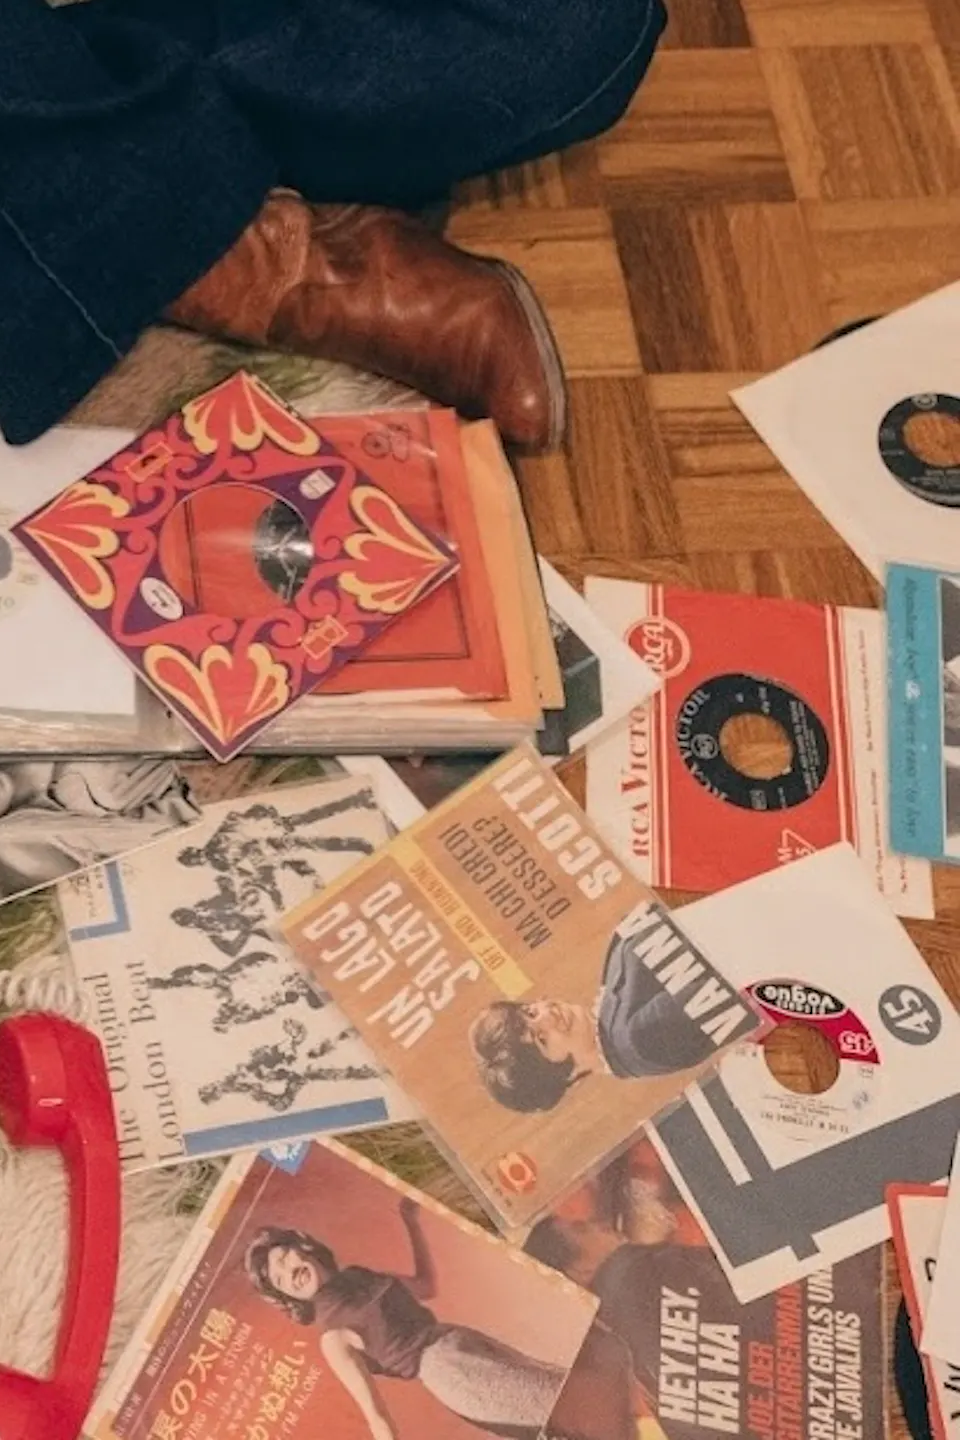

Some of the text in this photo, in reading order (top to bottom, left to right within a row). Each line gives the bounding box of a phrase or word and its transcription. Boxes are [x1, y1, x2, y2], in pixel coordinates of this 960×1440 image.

[621, 705, 649, 857] RCA VICTO
[676, 688, 711, 761] VICTOR
[437, 821, 553, 950] MA CHI CREDI
[455, 915, 482, 945] AND
[492, 757, 749, 1047] VANNA SCOTTI
[300, 900, 435, 1050] UN LAGO
[359, 880, 482, 1011] SALATO
[83, 971, 131, 1094] Original
[125, 960, 187, 1163] London Beat
[883, 988, 934, 1035] 45
[807, 1264, 834, 1305] UN
[807, 1305, 835, 1375] GIRLS
[658, 1352, 697, 1425] HEY
[697, 1321, 740, 1435] HA HA
[748, 1340, 775, 1388] DER
[836, 1310, 863, 1422] JAVALINS
